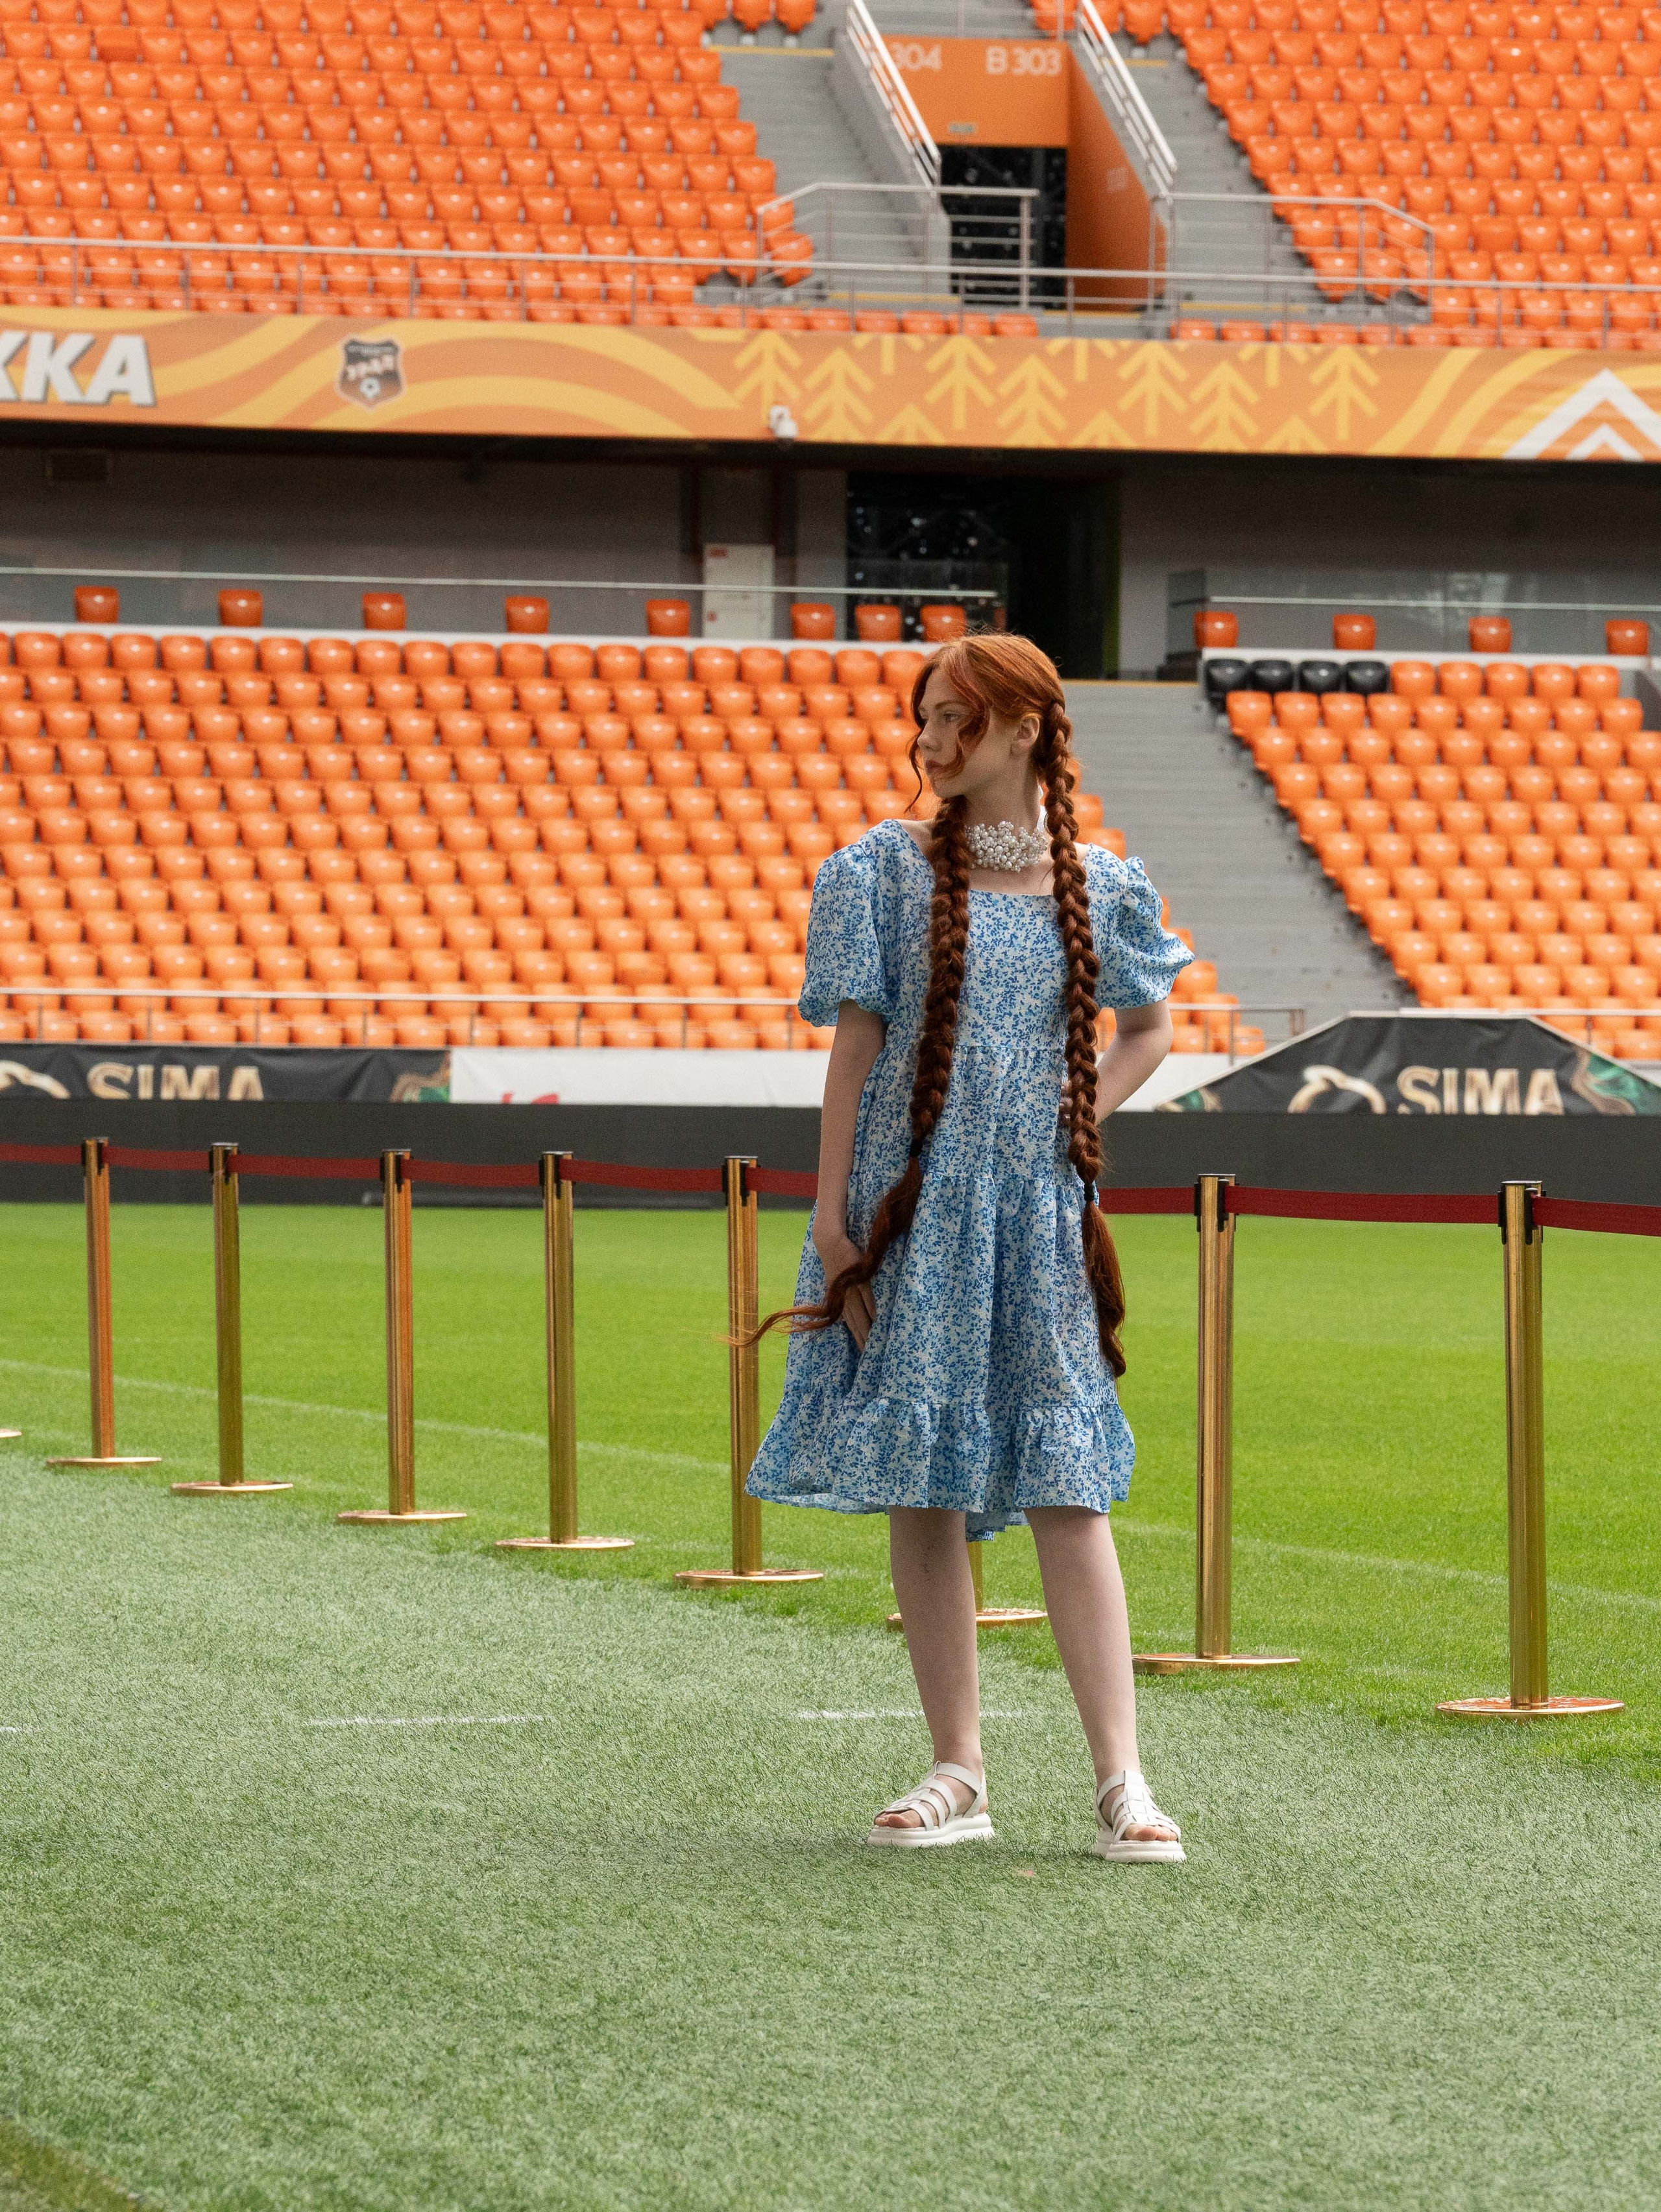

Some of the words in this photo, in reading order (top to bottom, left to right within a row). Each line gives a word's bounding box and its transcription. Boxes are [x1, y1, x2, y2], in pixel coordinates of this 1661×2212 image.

[1012, 46, 1062, 77] 303
[87, 1062, 264, 1101] SIMA
[1397, 1065, 1565, 1115] SIMA
